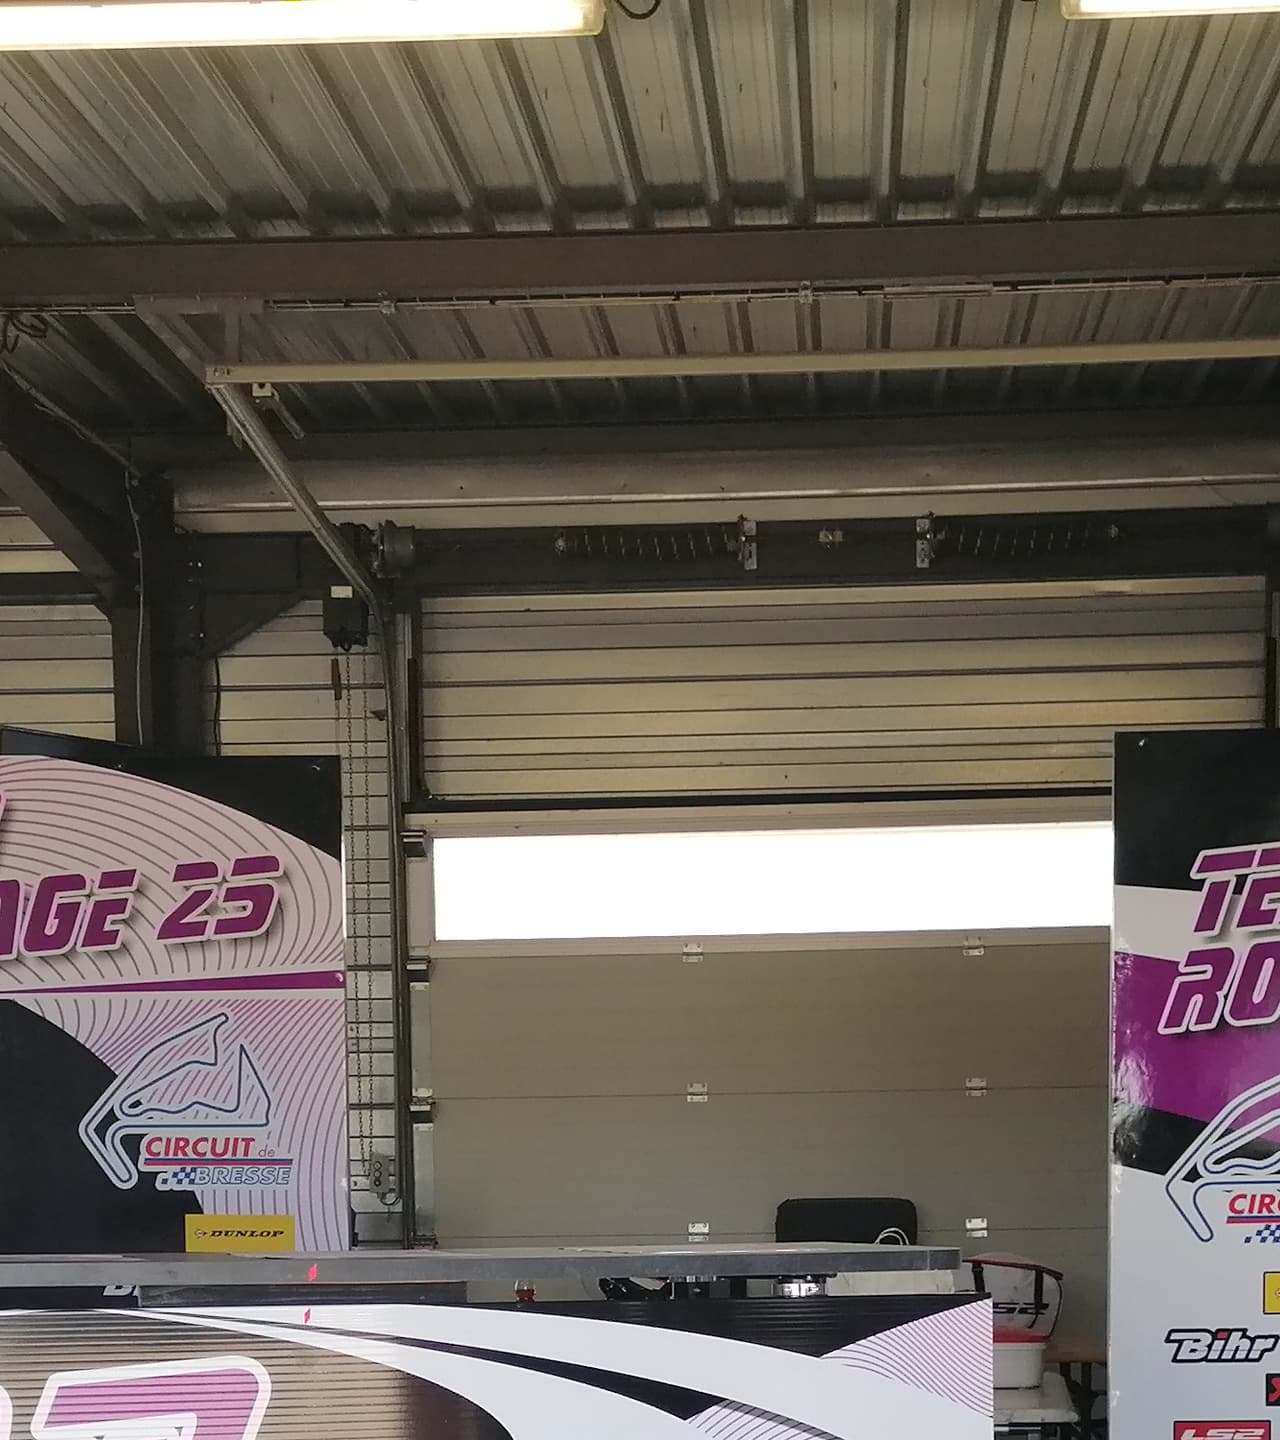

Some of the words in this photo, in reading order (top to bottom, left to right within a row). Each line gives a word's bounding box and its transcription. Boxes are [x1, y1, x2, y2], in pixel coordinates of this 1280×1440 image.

[155, 853, 285, 943] 25
[145, 1136, 256, 1158] CIRCUIT
[258, 1144, 276, 1158] de
[194, 1166, 292, 1186] BRESSE
[209, 1229, 285, 1239] DUNLOP
[1166, 1329, 1279, 1362] Bihr
[1180, 1428, 1265, 1440] LS2
